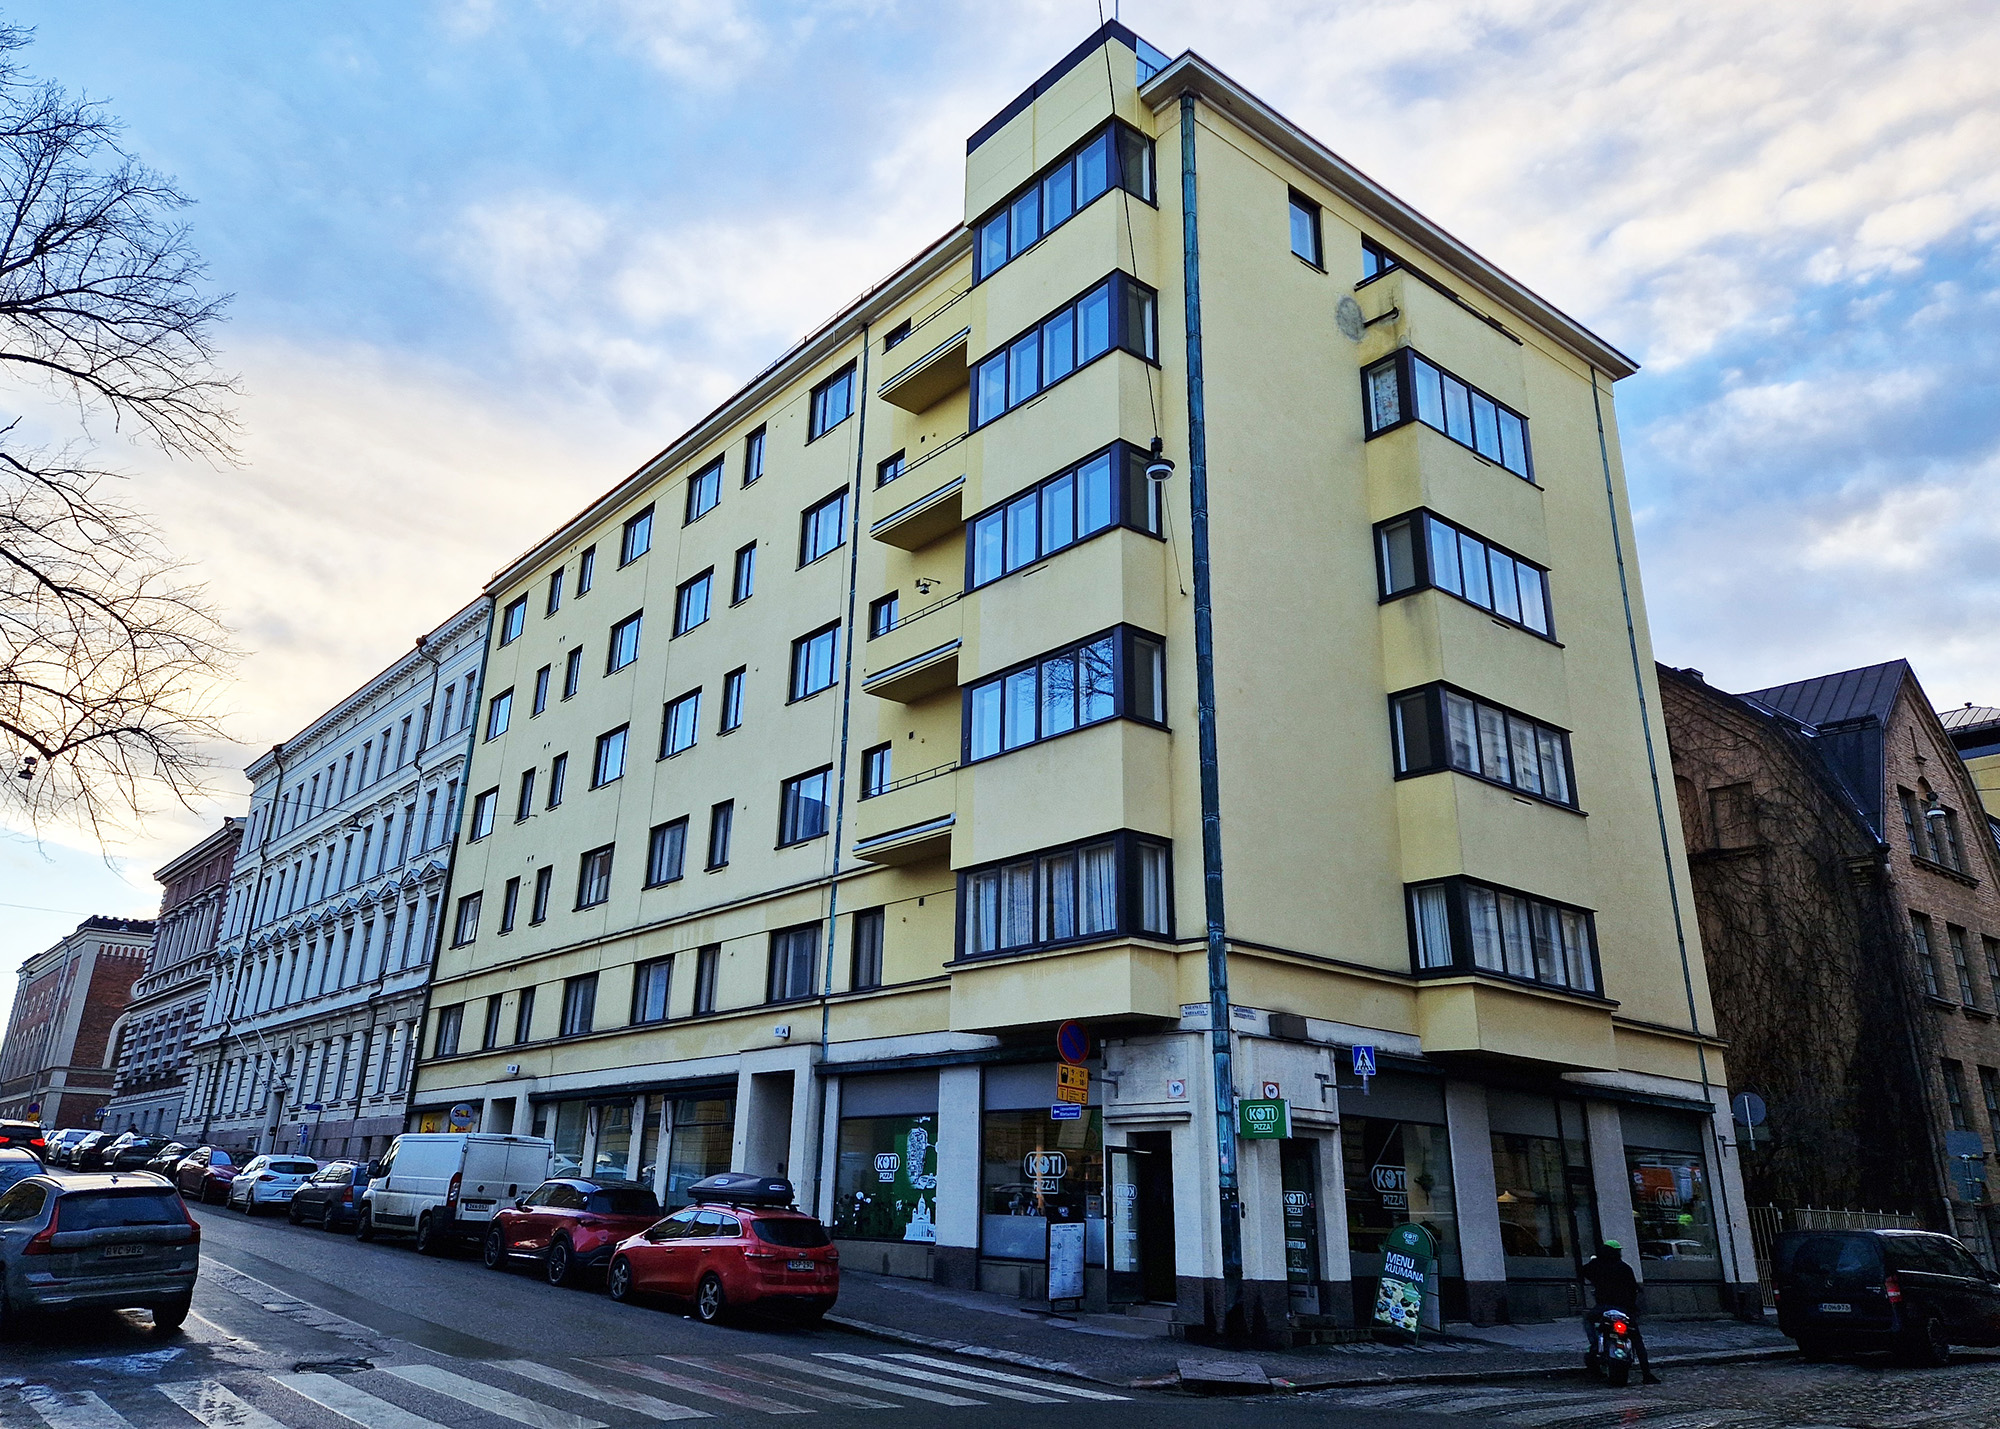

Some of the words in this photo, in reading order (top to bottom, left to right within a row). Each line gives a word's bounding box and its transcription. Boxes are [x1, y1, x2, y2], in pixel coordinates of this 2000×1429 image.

[454, 1109, 471, 1118] SOL
[1249, 1107, 1275, 1121] KOTI
[1253, 1123, 1271, 1131] PIZZA
[877, 1156, 897, 1170] KOTI
[1029, 1155, 1062, 1175] KOTI
[879, 1172, 894, 1180] PIZZA
[1033, 1180, 1056, 1191] PIZZA
[1284, 1193, 1304, 1205] KOTI
[1383, 1194, 1405, 1206] PIZZA
[1286, 1206, 1301, 1214] PIZZA
[1386, 1252, 1415, 1269] MENU
[1384, 1262, 1424, 1283] KUUMANA
